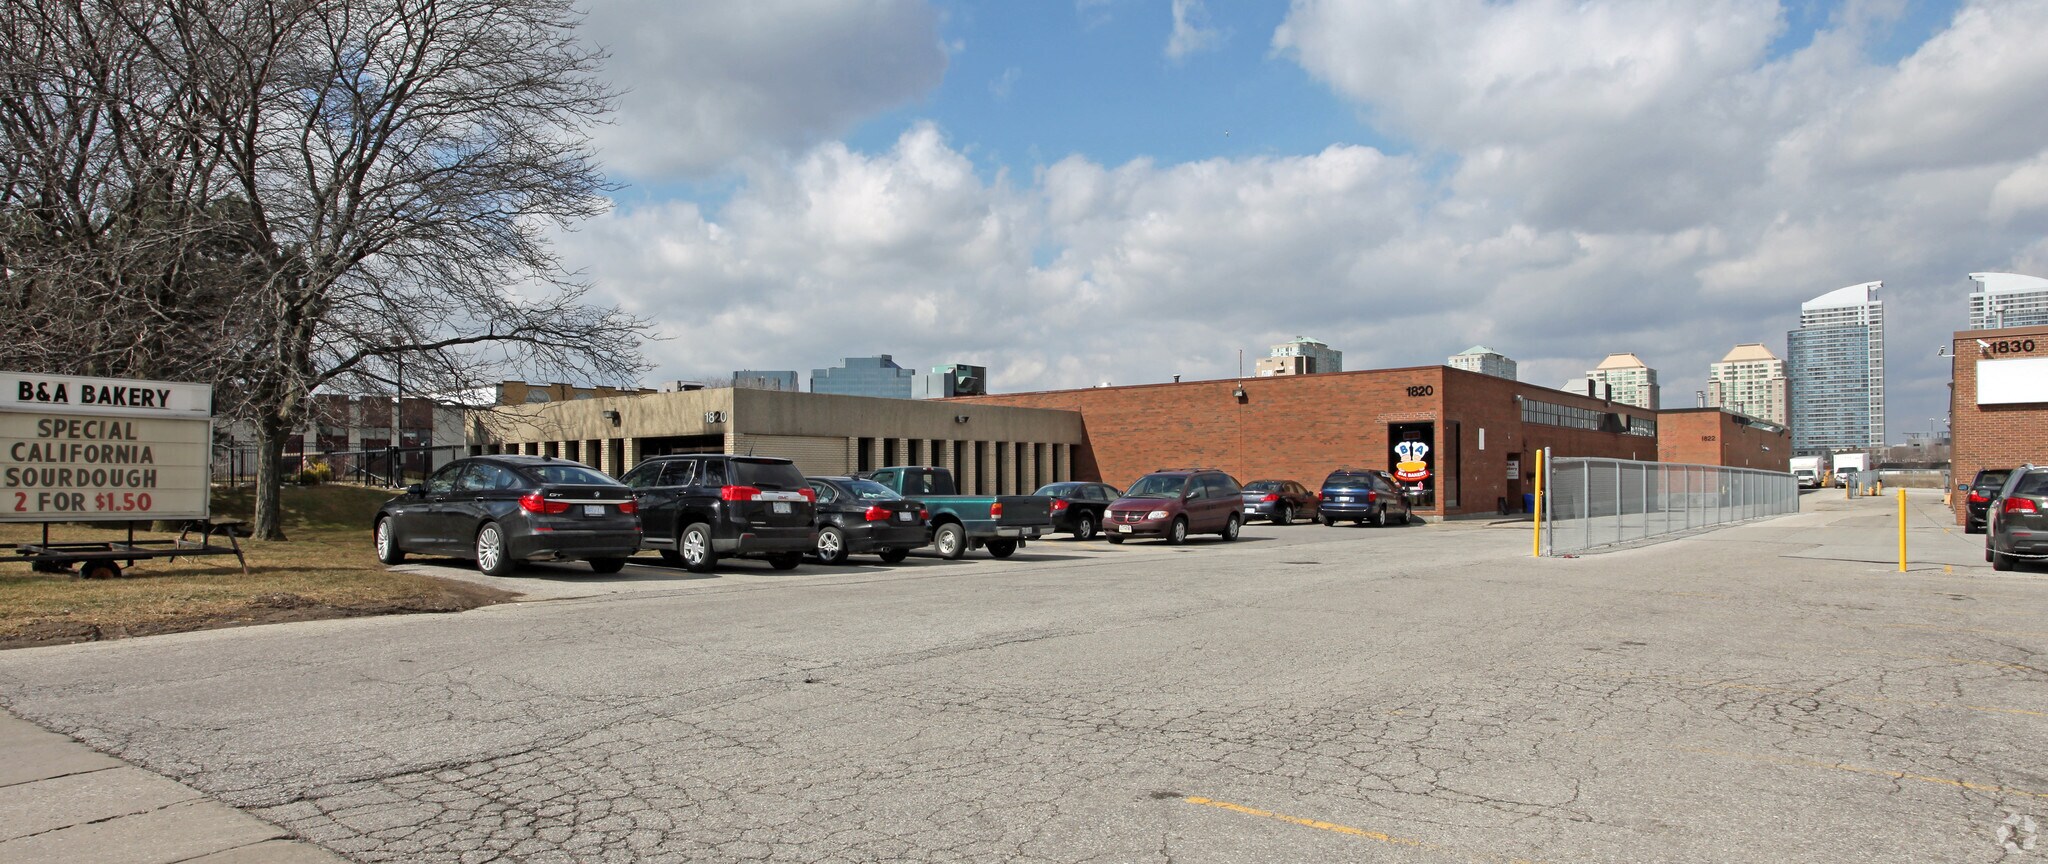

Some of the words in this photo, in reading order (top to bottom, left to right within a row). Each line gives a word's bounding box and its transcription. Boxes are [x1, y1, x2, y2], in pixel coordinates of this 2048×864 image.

[1990, 340, 2035, 354] 1830
[18, 381, 69, 403] B&A
[81, 384, 170, 407] BAKERY
[1406, 385, 1433, 397] 1820
[705, 411, 727, 423] 1820
[38, 418, 137, 440] SPECIAL
[11, 442, 153, 464] CALIFORNIA
[1400, 445, 1408, 454] B
[1415, 445, 1423, 455] A
[6, 467, 157, 489] SOURDOUGH
[14, 492, 27, 512] 2
[38, 492, 86, 511] FOR
[95, 492, 152, 512] $1.50
